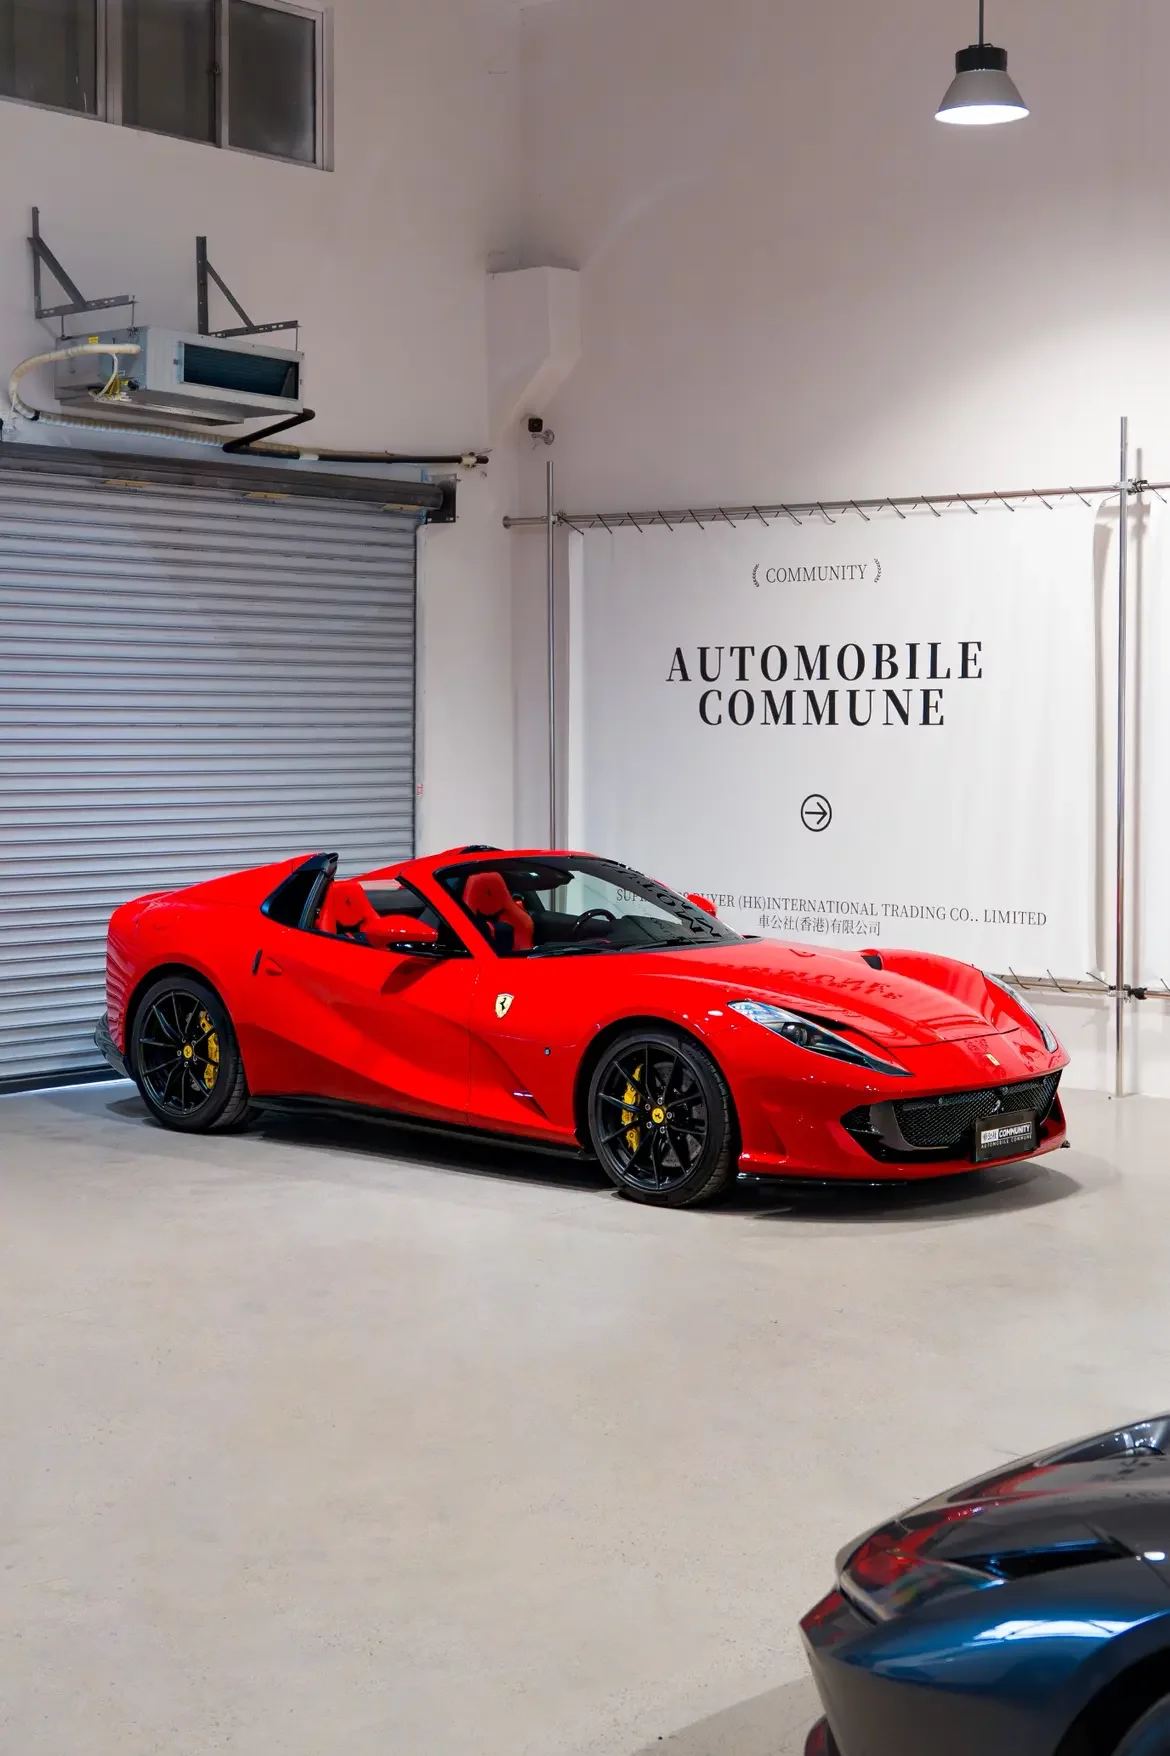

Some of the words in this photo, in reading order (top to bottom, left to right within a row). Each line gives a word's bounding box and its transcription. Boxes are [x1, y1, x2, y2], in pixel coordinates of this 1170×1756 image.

[765, 563, 868, 584] COMMUNITY
[665, 640, 983, 682] AUTOMOBILE
[698, 687, 945, 727] COMMUNE
[881, 903, 946, 921] TRADING
[984, 909, 1047, 926] LIMITED
[998, 1124, 1031, 1138] COMMUNITY
